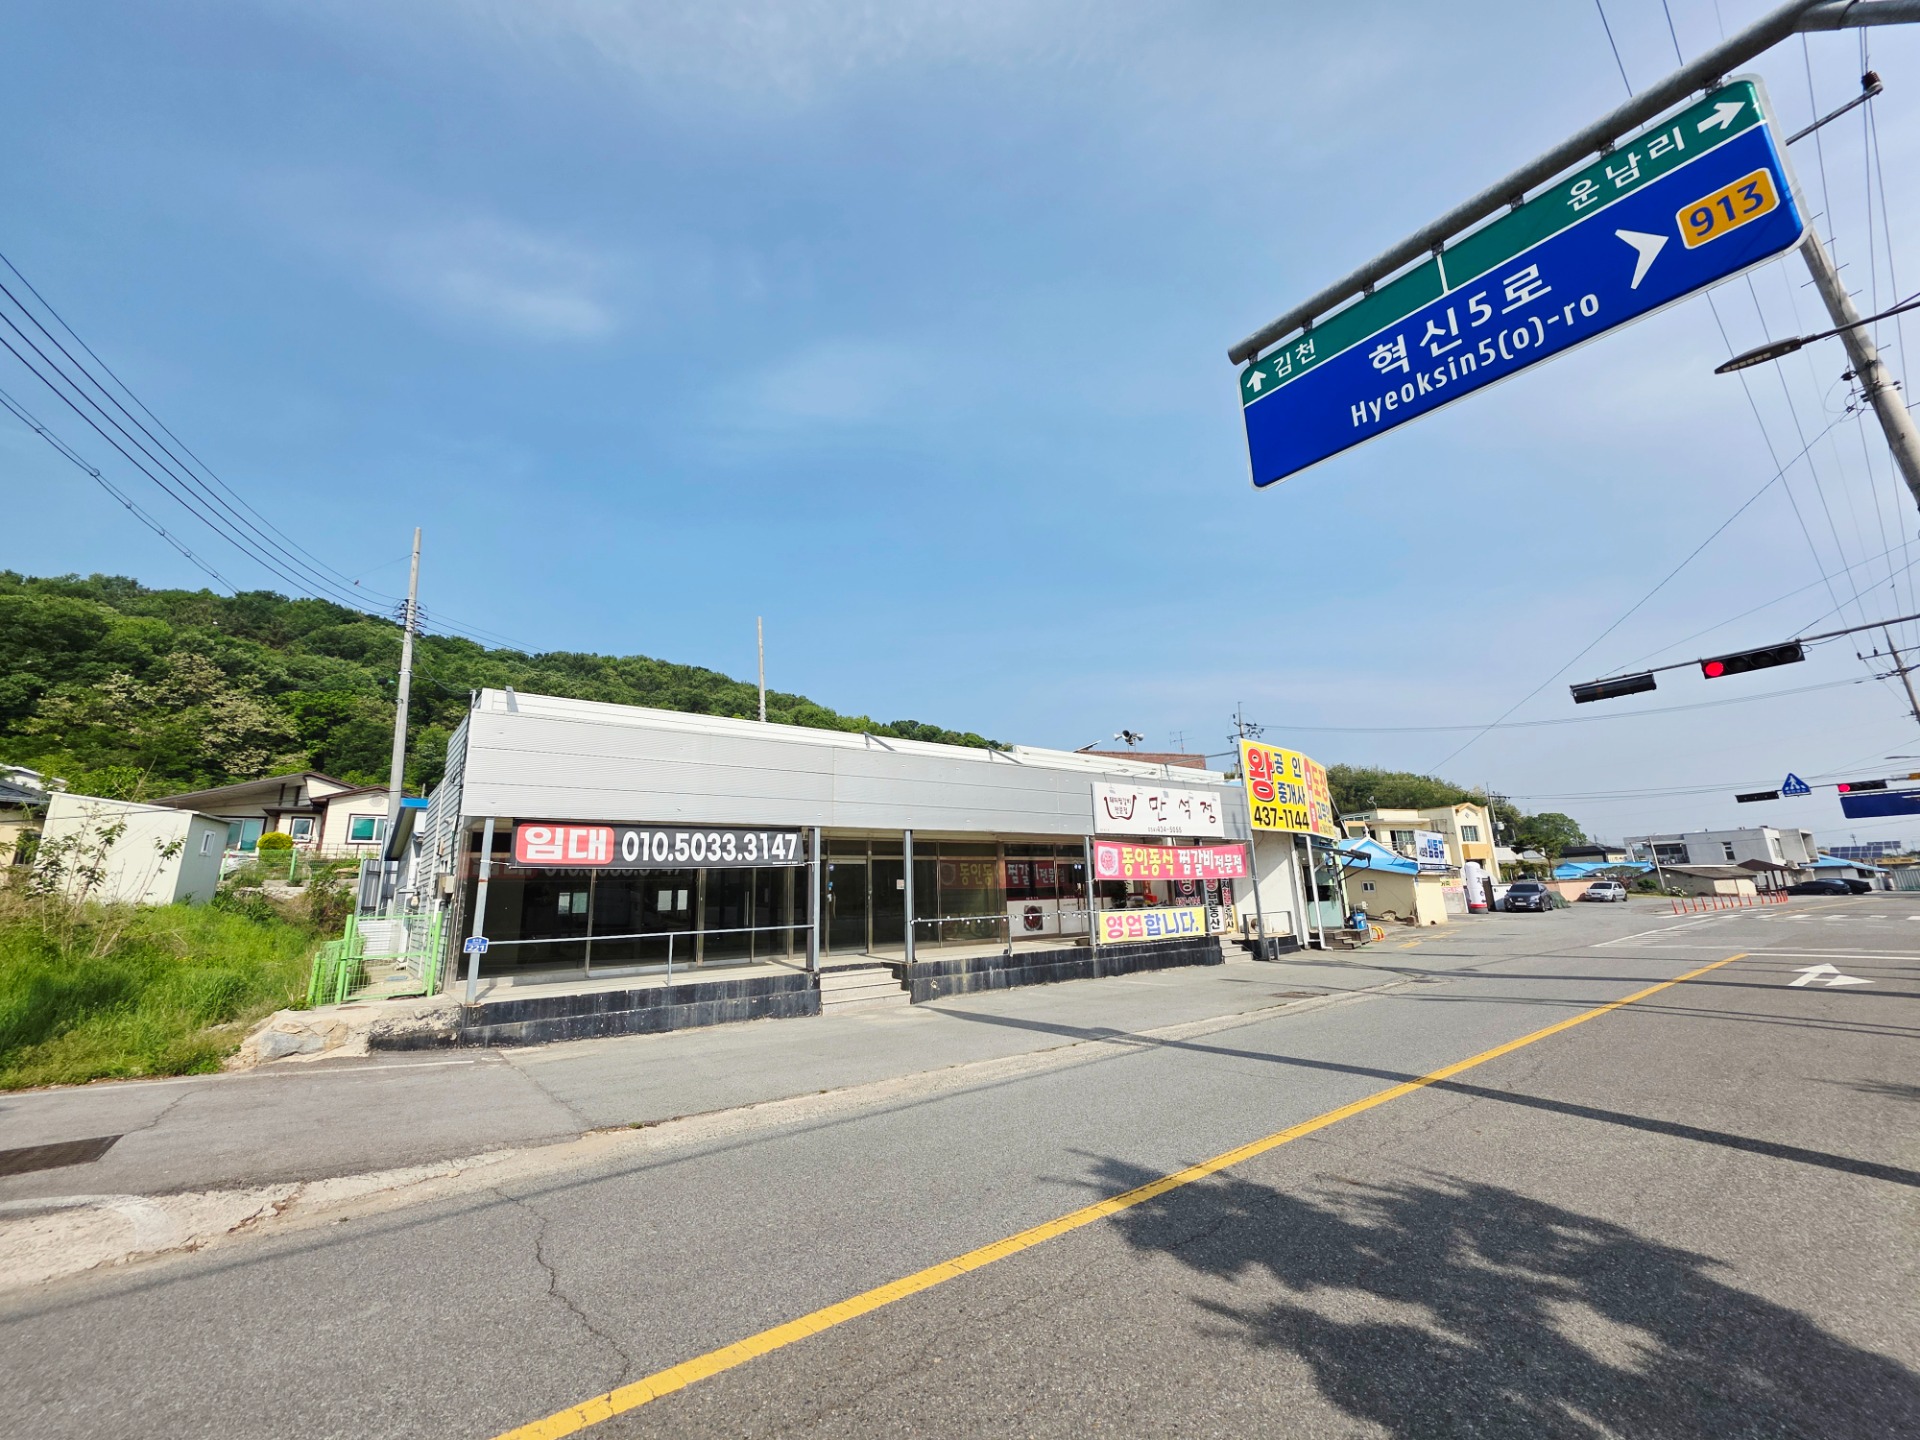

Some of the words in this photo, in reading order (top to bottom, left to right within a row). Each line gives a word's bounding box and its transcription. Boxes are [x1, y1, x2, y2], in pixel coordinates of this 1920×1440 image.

[1567, 127, 1686, 211] 운남리
[1689, 179, 1765, 237] 913
[1368, 264, 1552, 375] 혁신5로
[1273, 341, 1317, 378] 김천
[1351, 293, 1600, 427] Hyeoksin5(o)-ro
[1247, 748, 1275, 802] 왕
[1277, 781, 1306, 806] 중개사
[1254, 805, 1310, 829] 437-1144
[524, 827, 607, 861] 임대
[621, 831, 798, 862] 010.5033.3147
[1121, 847, 1174, 877] 동인동식
[1105, 911, 1200, 939] 영업합니다.
